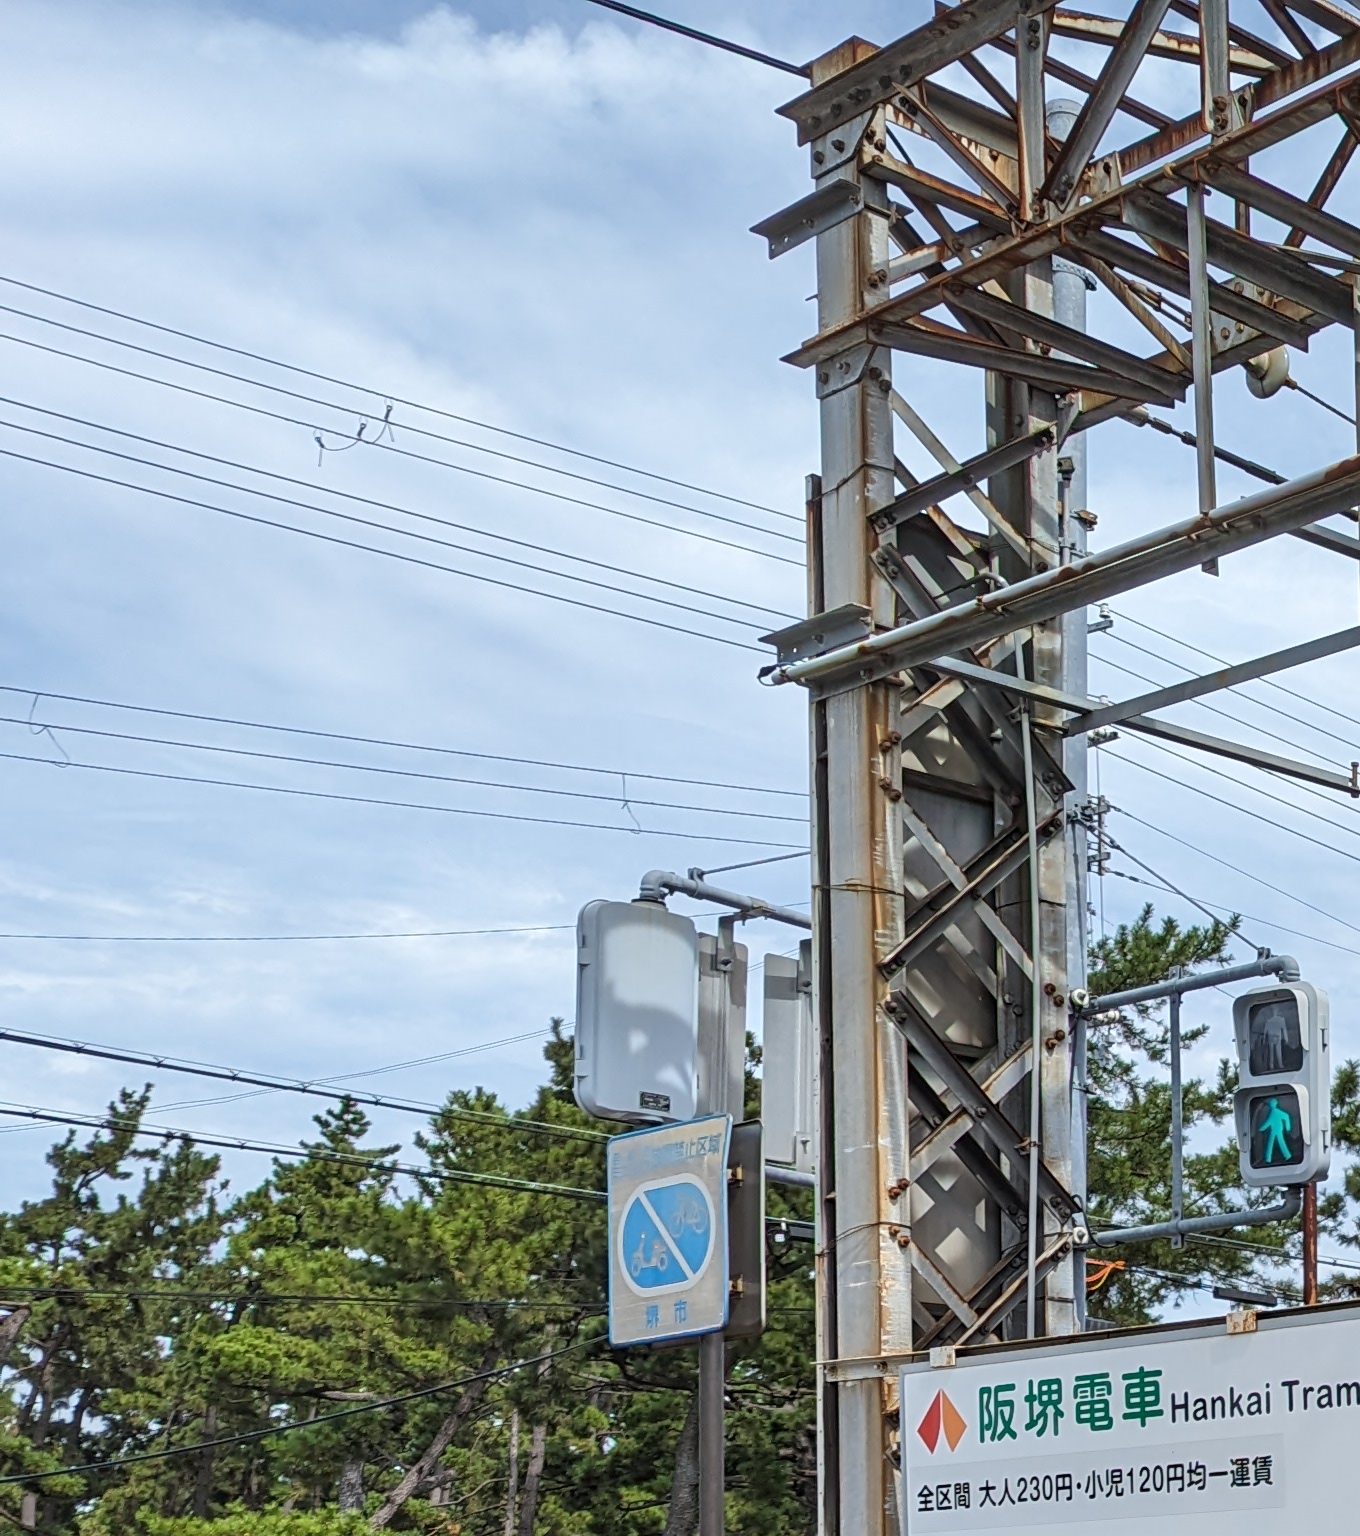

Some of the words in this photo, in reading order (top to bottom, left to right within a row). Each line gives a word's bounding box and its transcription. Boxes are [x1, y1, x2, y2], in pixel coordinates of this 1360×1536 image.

[978, 1365, 1164, 1444] 阪堺電車
[1169, 1382, 1272, 1424] Hankai
[916, 1482, 971, 1513] 全区間
[978, 1454, 1275, 1510] 大人230円・小児120円均一運賃
